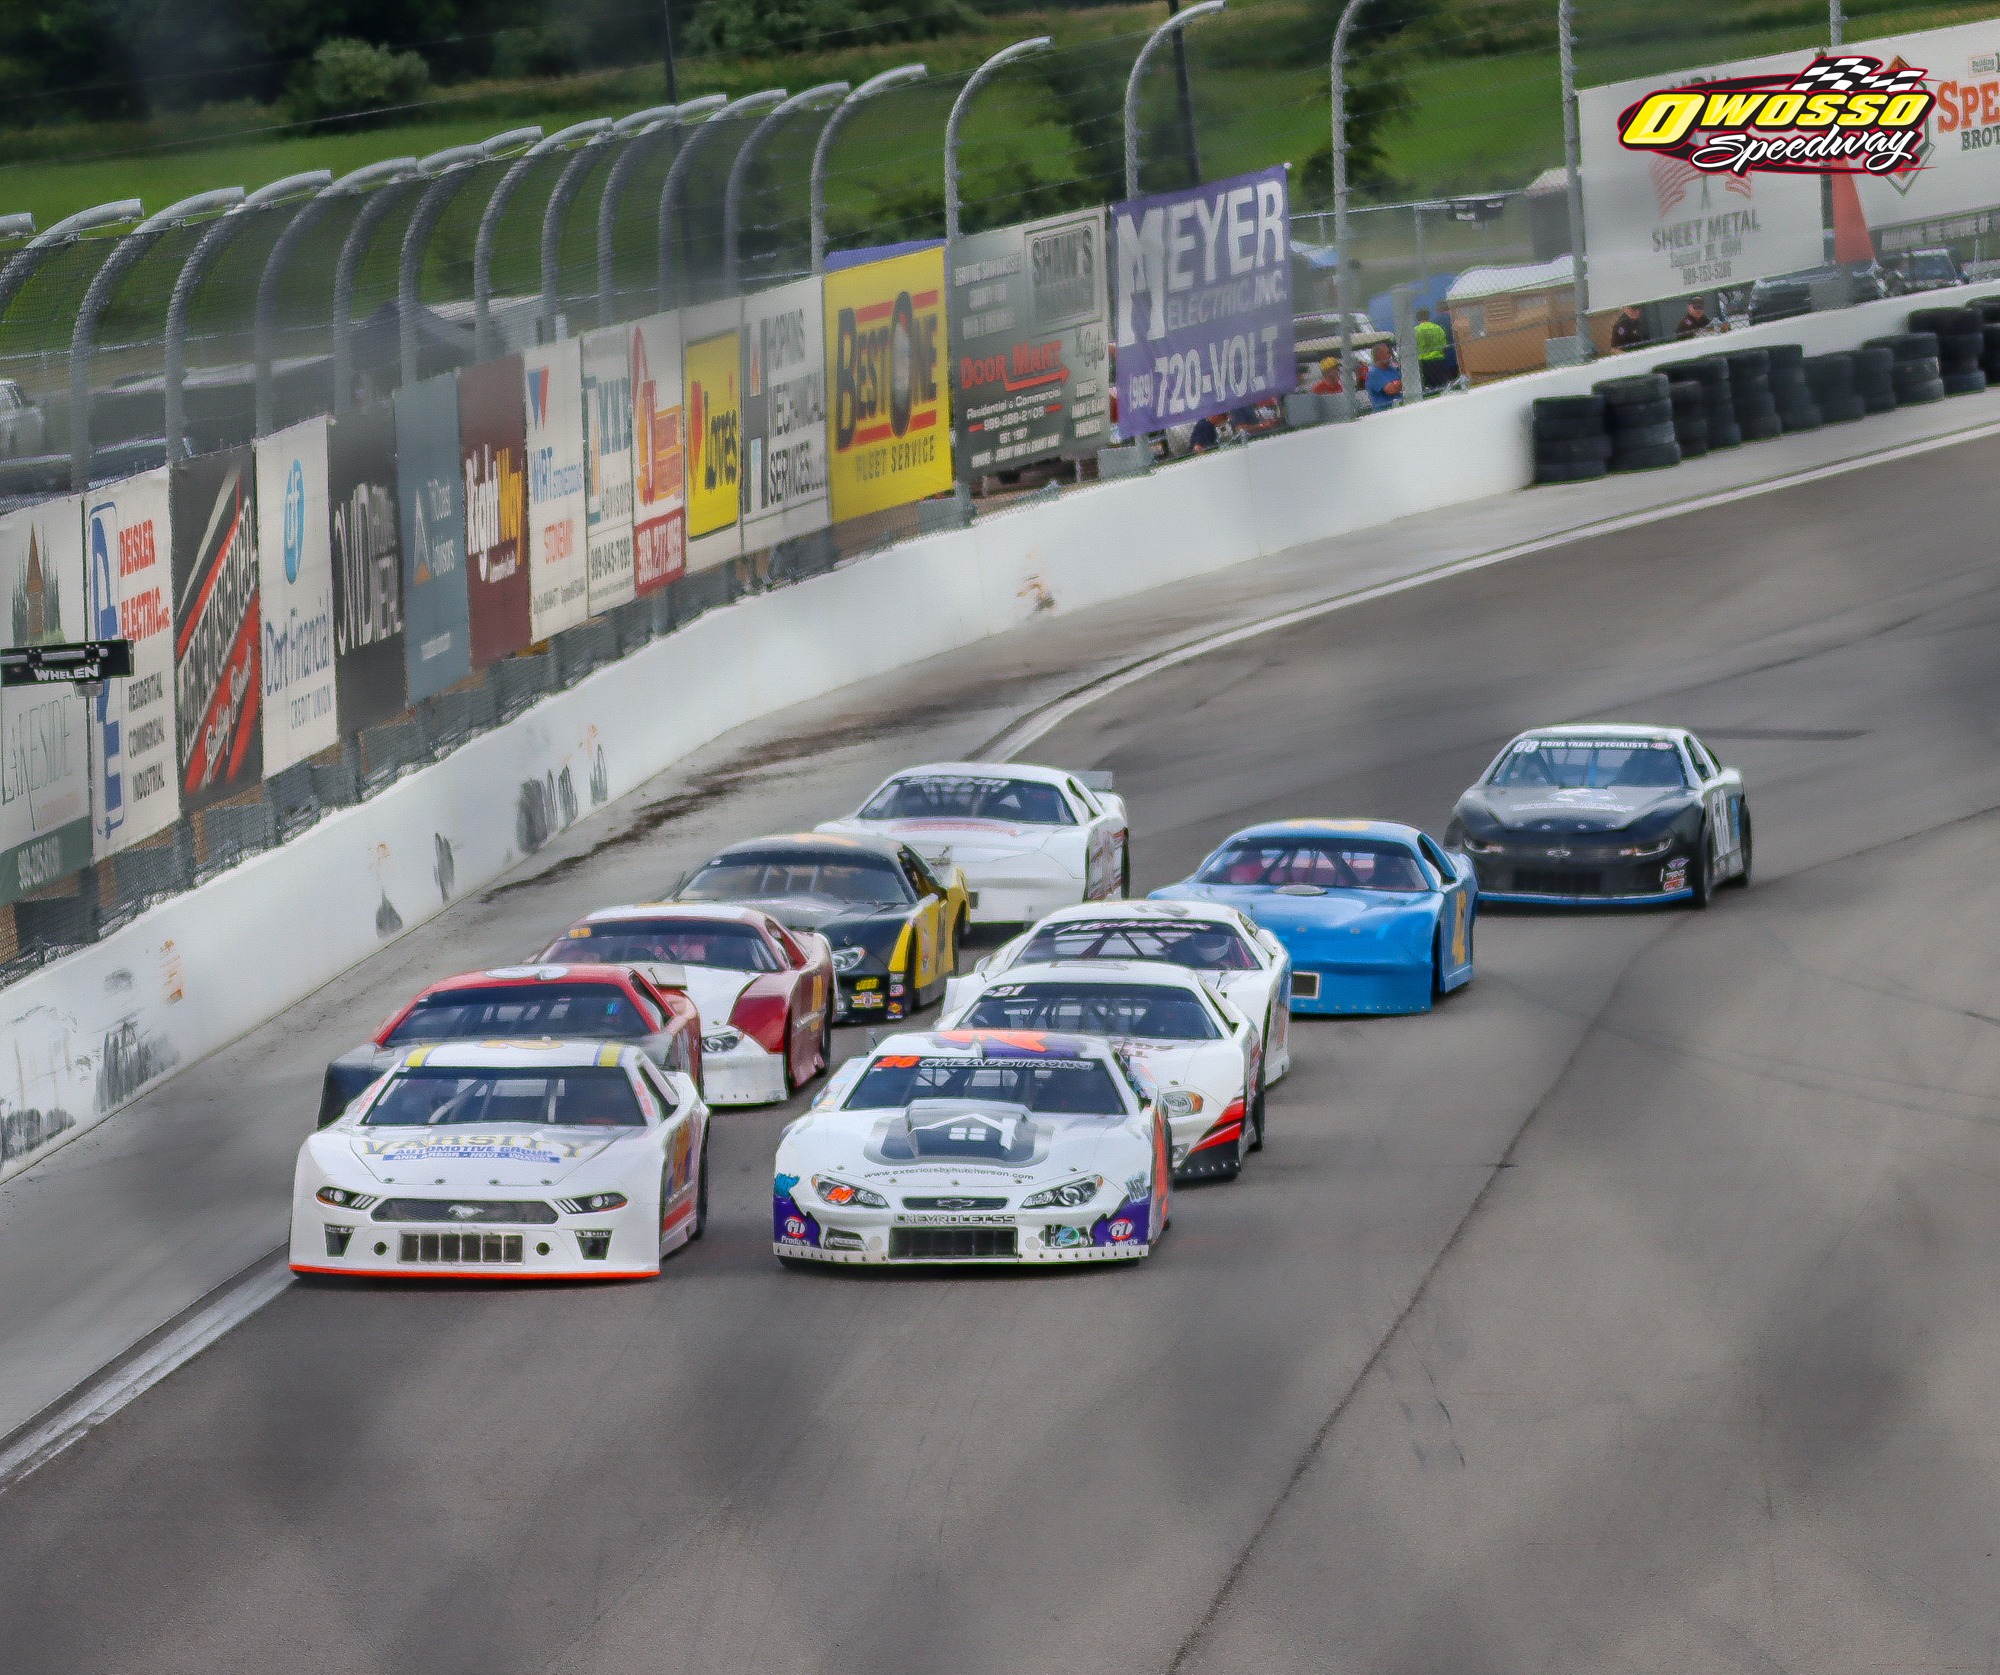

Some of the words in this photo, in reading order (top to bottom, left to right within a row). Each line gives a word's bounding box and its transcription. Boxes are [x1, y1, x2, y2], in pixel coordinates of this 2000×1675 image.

[1651, 218, 1703, 253] SHEET
[1707, 207, 1762, 242] METAL
[1117, 179, 1285, 348] MEYER
[1166, 279, 1250, 331] ELECTRIC
[961, 351, 1006, 390] DOOR
[1012, 339, 1063, 376] MART
[1155, 325, 1280, 419] 720-VOLT
[890, 434, 935, 473] SERVICE
[119, 518, 157, 578] DEISLER
[121, 586, 161, 642] ELECTRIC
[265, 620, 288, 697] Dort
[290, 588, 330, 685] Financial
[34, 664, 100, 682] WHELEN
[128, 670, 163, 714] RESIDENTIAL
[1594, 741, 1649, 749] SPECIALISTS
[132, 761, 165, 803] INDUSTRIAL
[363, 1135, 584, 1159] VARSITY
[395, 1145, 495, 1155] AUTOMOTIVE
[864, 1166, 1034, 1181] www.exteriorsbyhutcherson.com
